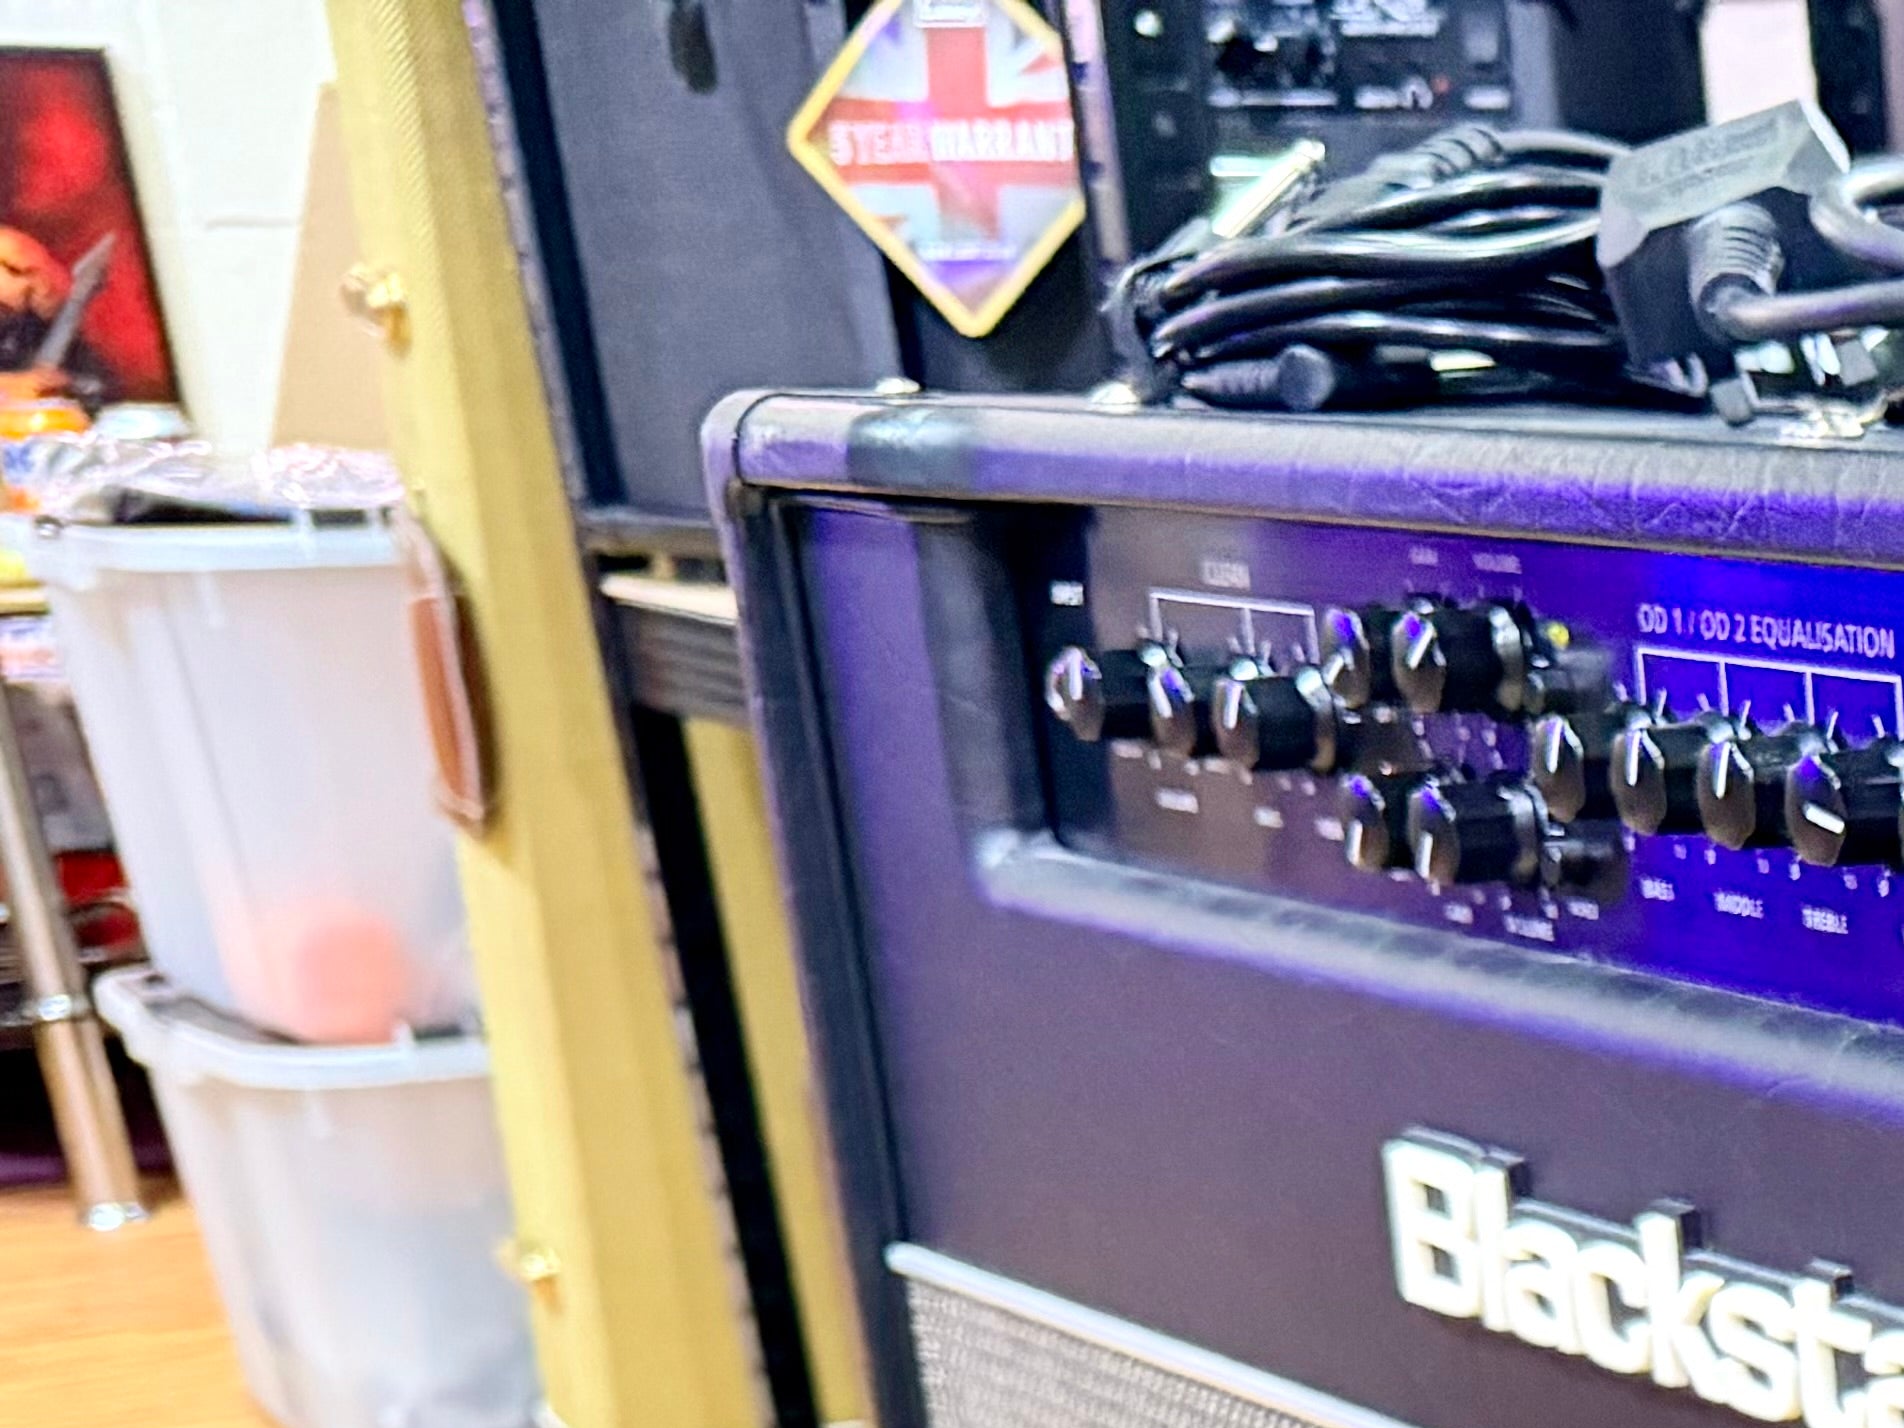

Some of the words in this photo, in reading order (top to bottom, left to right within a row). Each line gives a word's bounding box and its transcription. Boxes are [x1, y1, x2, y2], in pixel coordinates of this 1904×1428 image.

[1637, 603, 1668, 634] OD
[1671, 607, 1683, 636] 1
[1700, 609, 1731, 640] OD
[1733, 613, 1747, 643] 2
[1750, 614, 1895, 659] EQUALISATION
